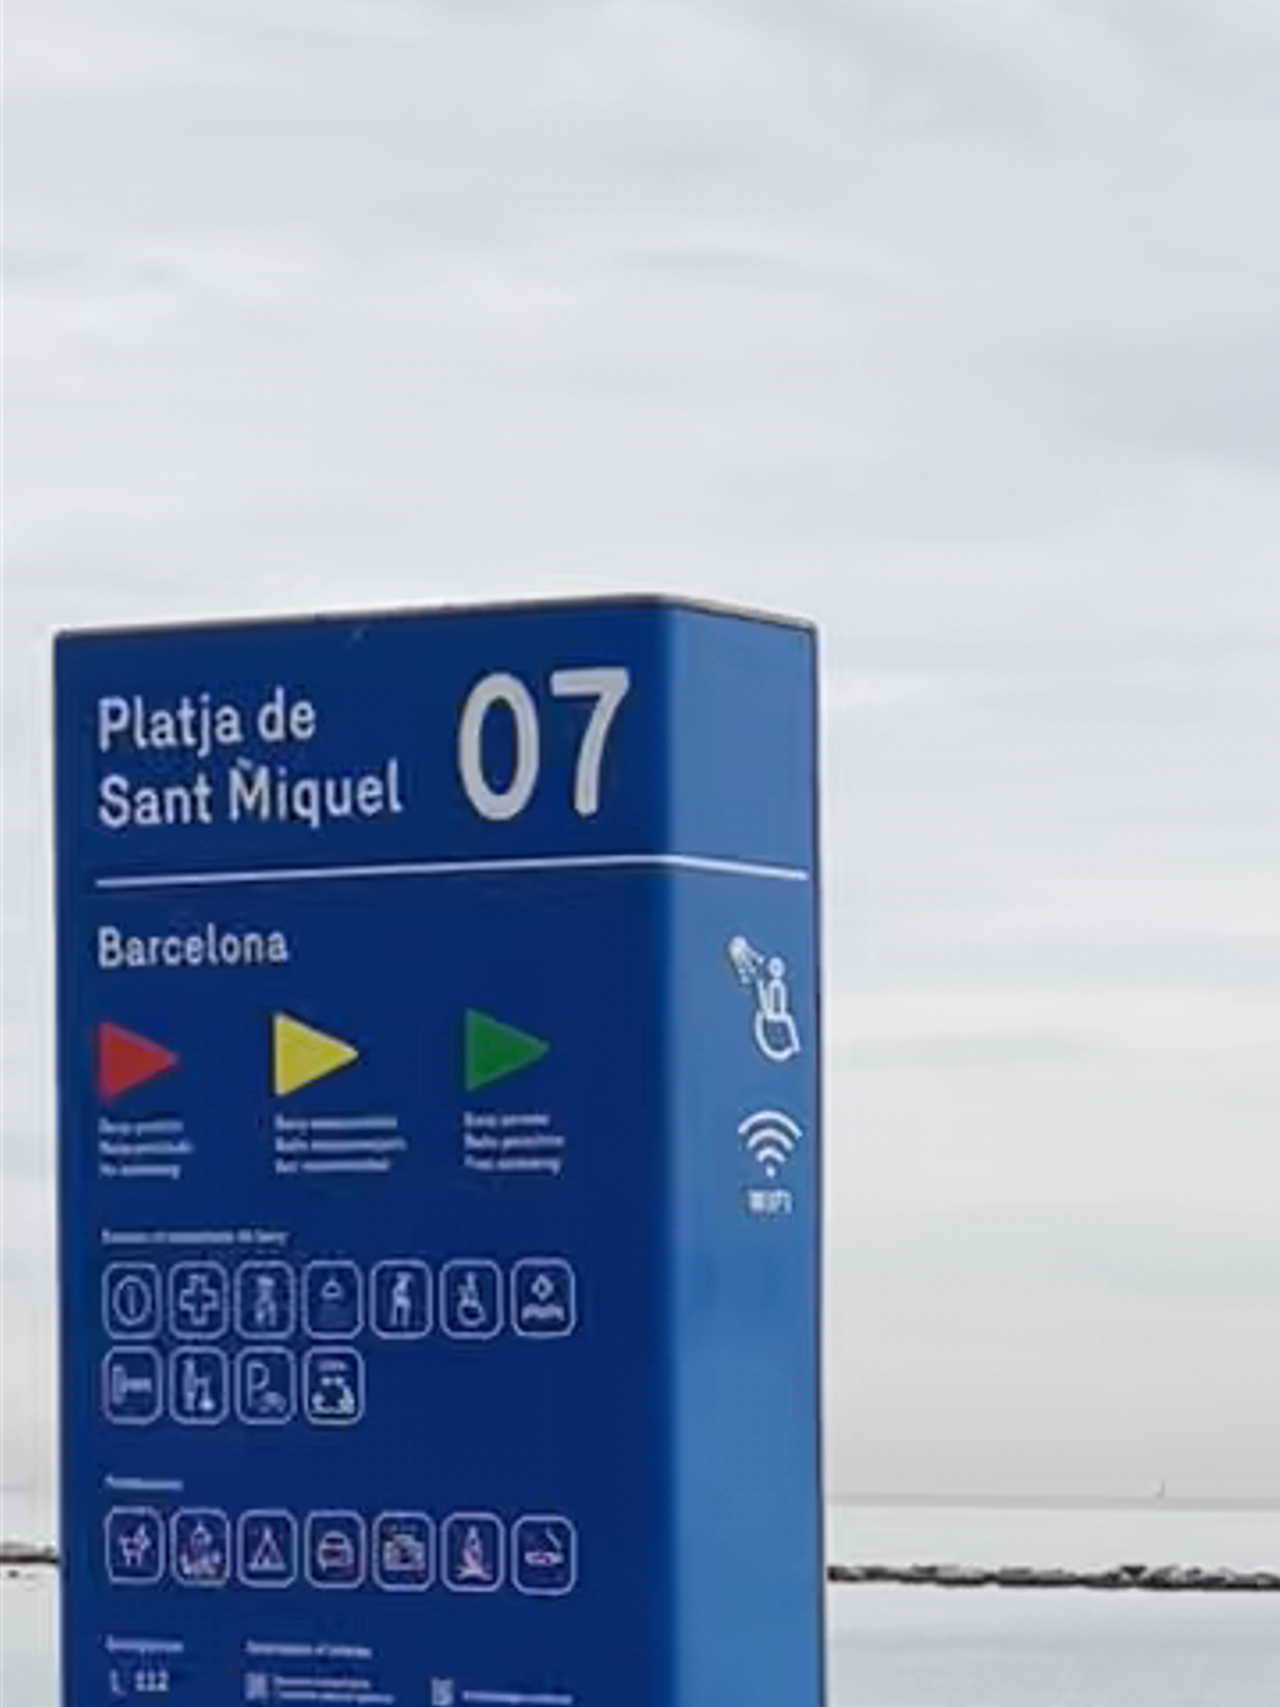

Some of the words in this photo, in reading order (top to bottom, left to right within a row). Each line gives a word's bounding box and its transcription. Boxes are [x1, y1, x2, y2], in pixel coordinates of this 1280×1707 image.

[99, 692, 242, 757] Platja
[256, 686, 316, 742] de
[457, 667, 630, 821] 07
[99, 773, 212, 828] Sant
[228, 757, 403, 829] Miquel
[98, 922, 290, 969] Barcelona
